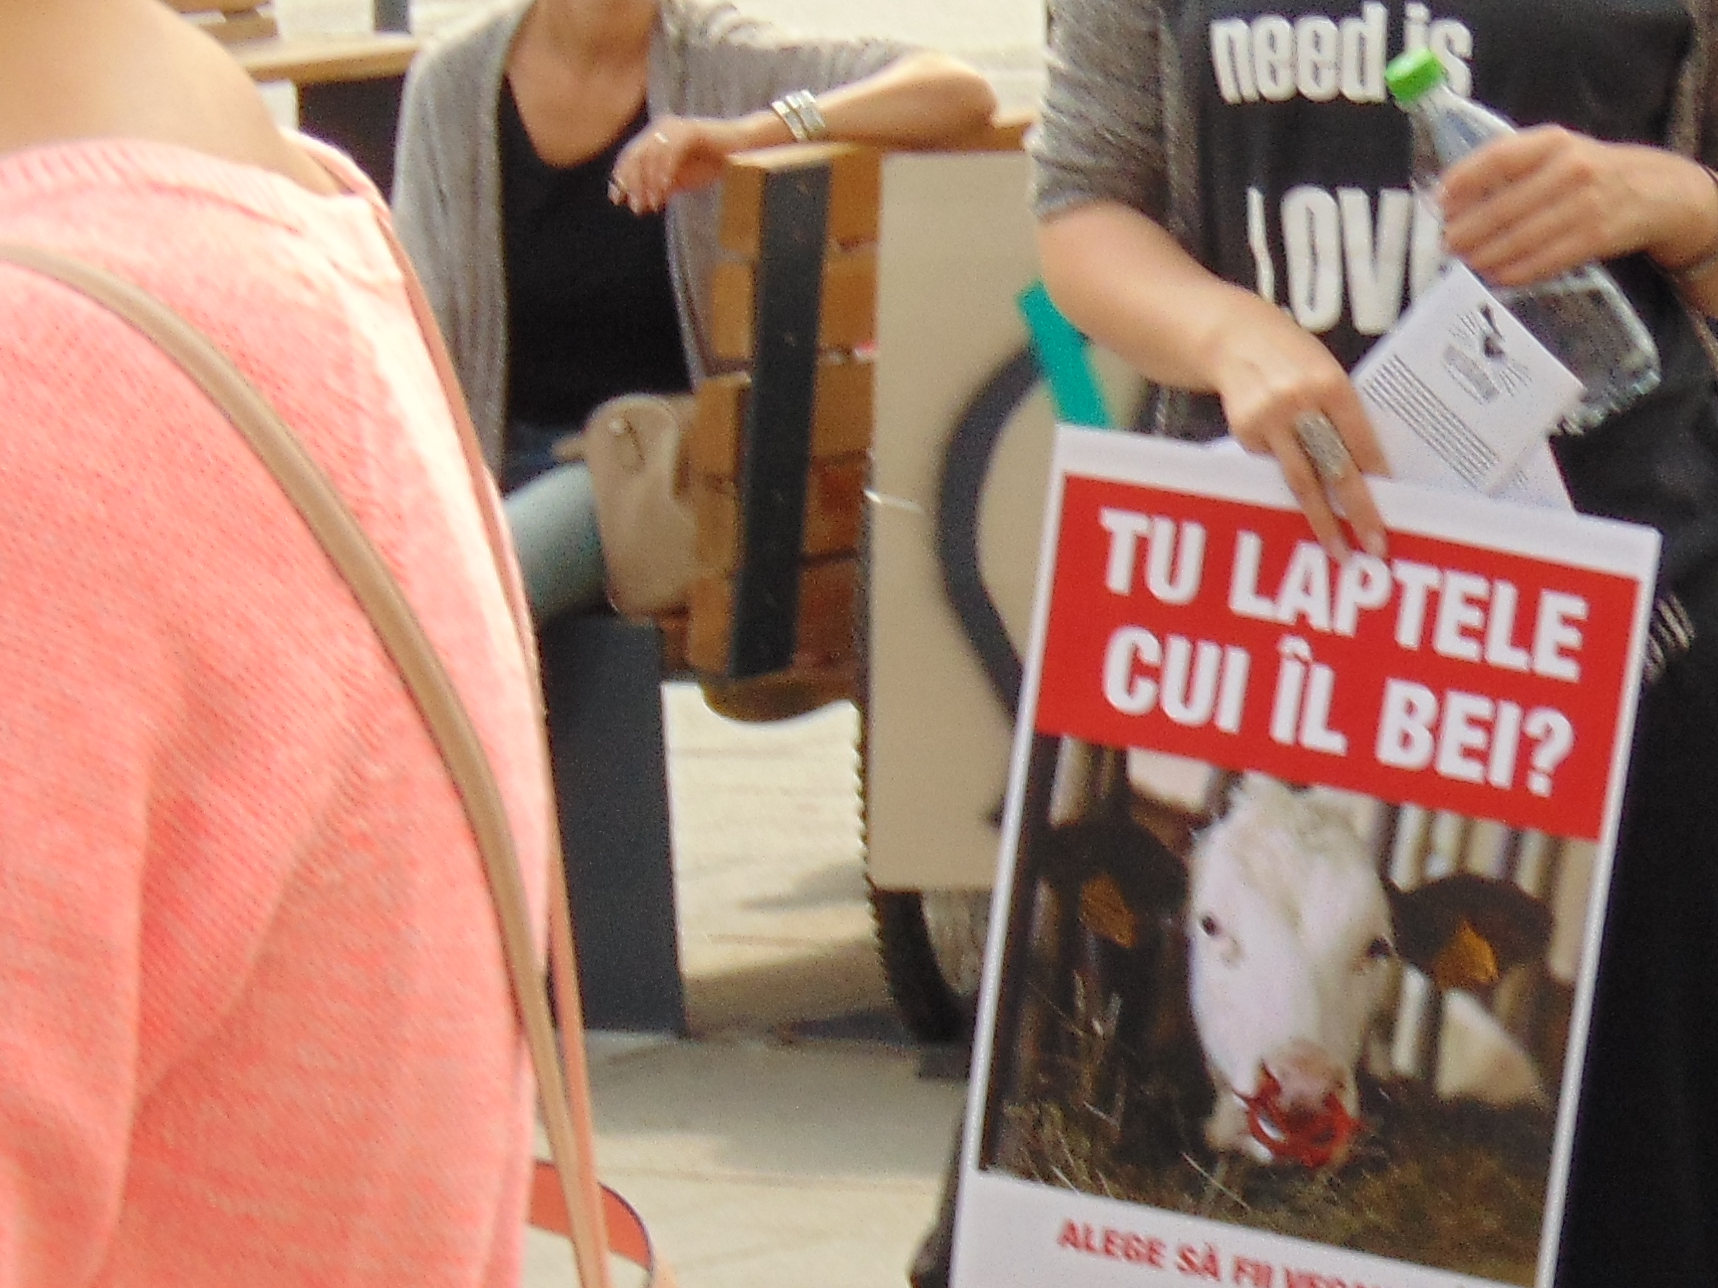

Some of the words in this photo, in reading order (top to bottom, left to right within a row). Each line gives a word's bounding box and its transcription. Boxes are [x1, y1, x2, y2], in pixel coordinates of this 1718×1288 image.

[1098, 506, 1206, 605] TU
[1226, 528, 1589, 683] LAPTELE
[1101, 623, 1250, 734] CUI
[1268, 634, 1348, 757] ÎL
[1375, 676, 1576, 798] BEI?
[1058, 1217, 1167, 1270] ALEGE
